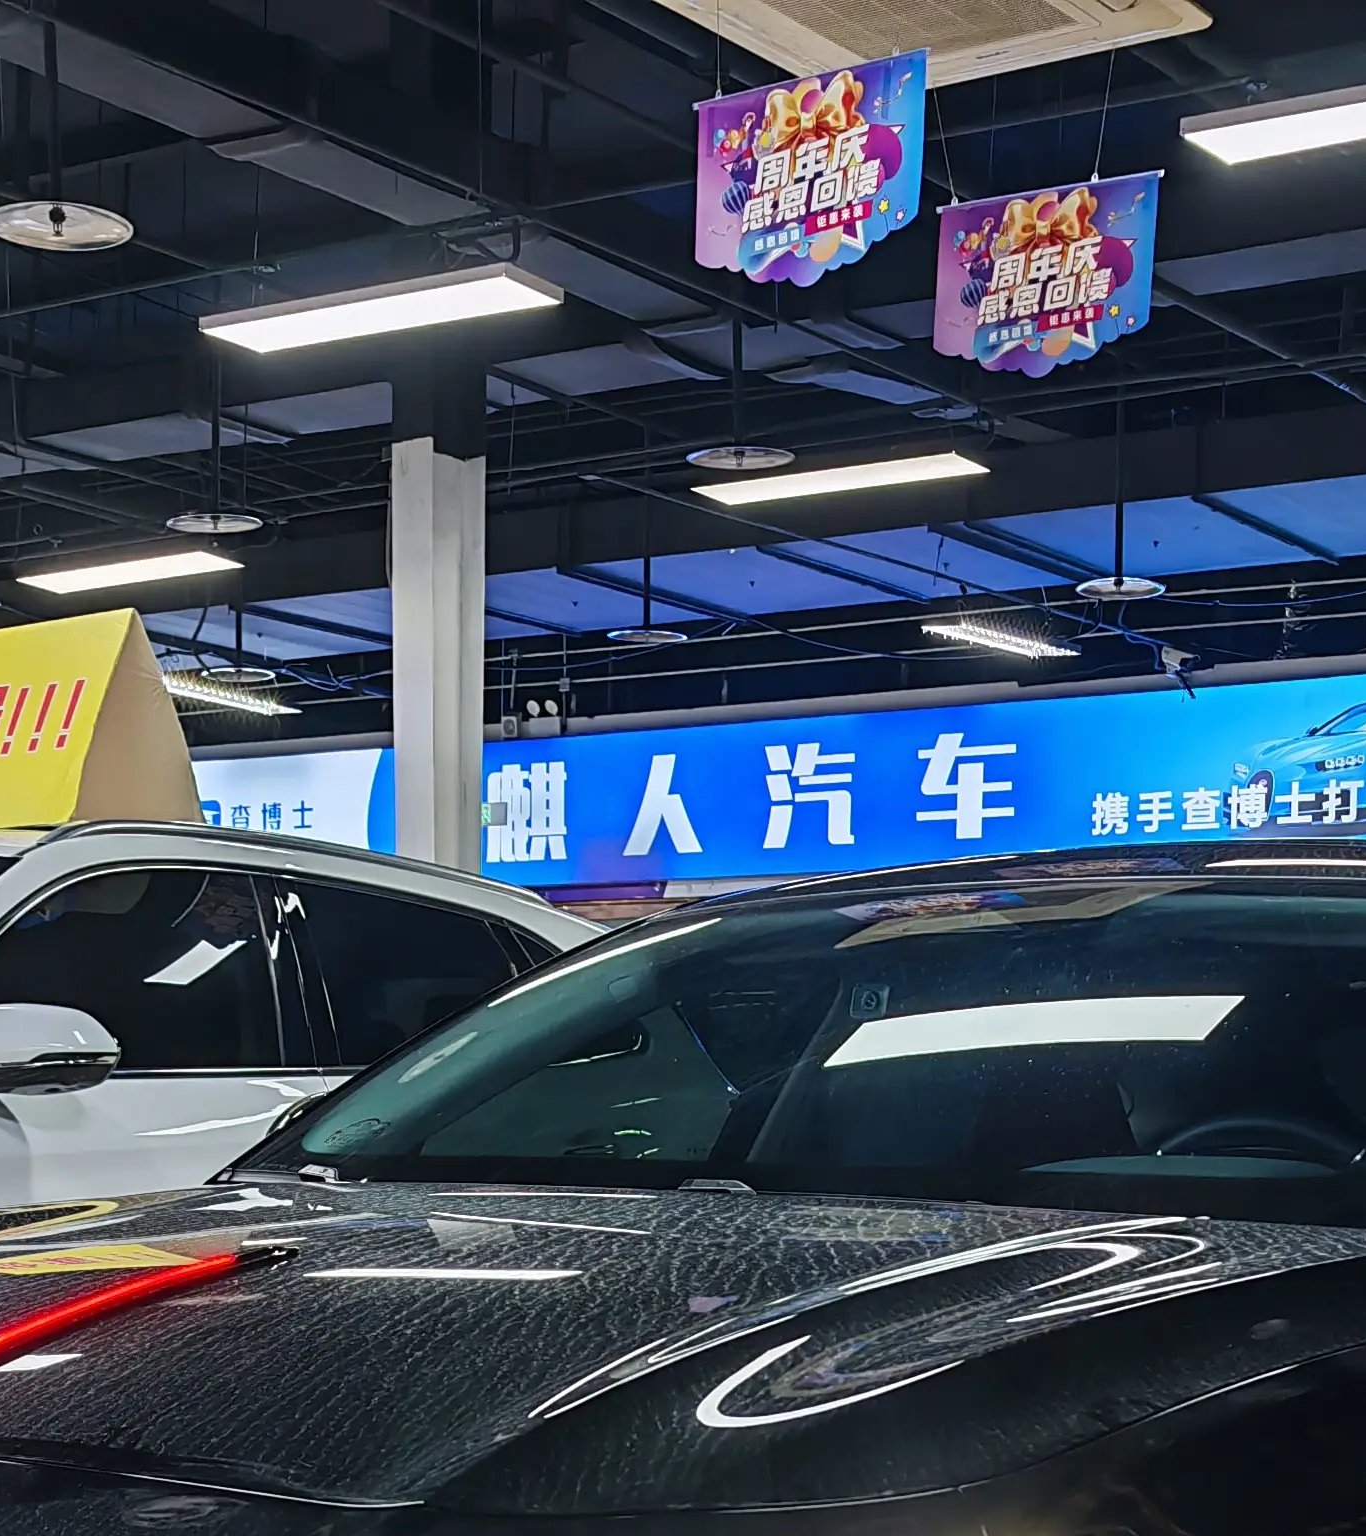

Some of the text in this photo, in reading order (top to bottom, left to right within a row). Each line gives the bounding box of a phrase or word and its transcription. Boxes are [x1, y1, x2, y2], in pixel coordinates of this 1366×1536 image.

[753, 124, 870, 195] 周年庆
[741, 158, 881, 234] 感恩回馈
[977, 267, 1113, 326] 感恩回馈
[990, 235, 1103, 292] 周年庆
[485, 732, 1017, 863] 麒人汽车
